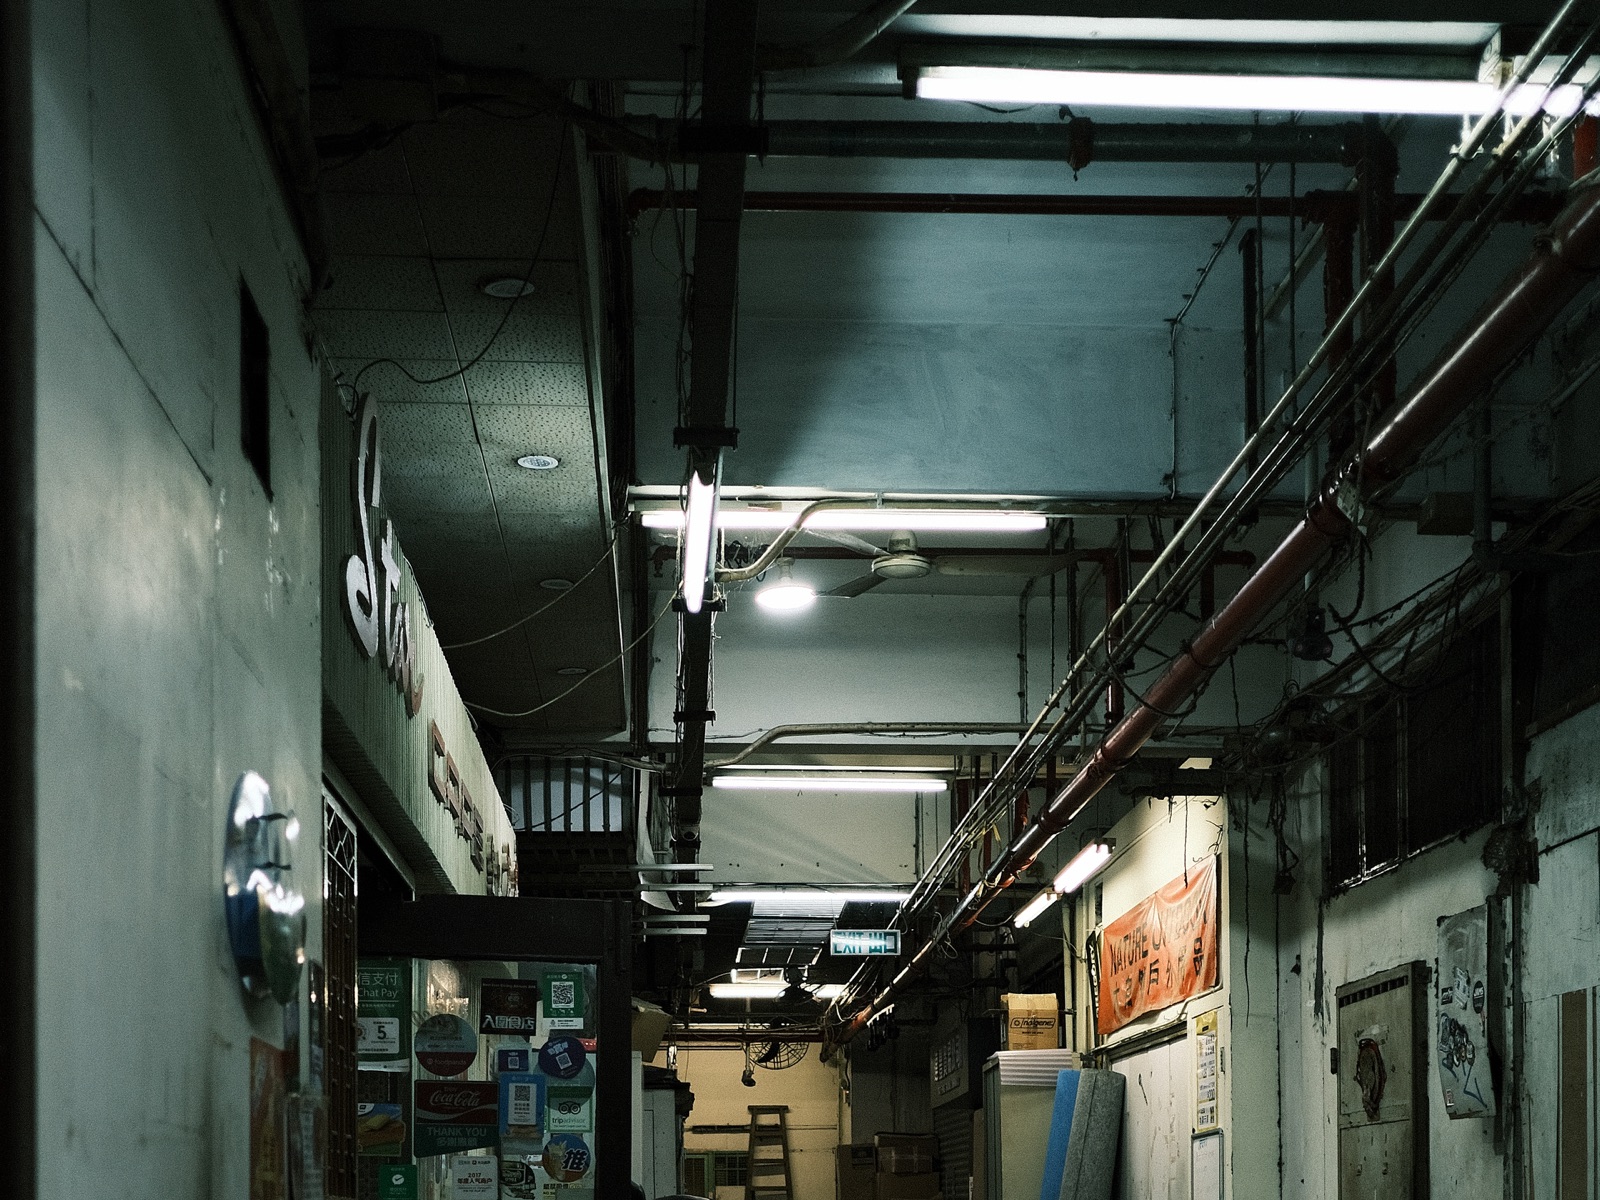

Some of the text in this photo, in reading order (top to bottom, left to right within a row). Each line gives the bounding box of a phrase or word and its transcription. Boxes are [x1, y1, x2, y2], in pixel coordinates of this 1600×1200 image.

[1110, 920, 1148, 977] NATURE
[381, 988, 398, 999] Pay
[377, 1025, 387, 1040] 5
[429, 1090, 482, 1107] Coca-Cola
[427, 1127, 487, 1137] THANK YOU
